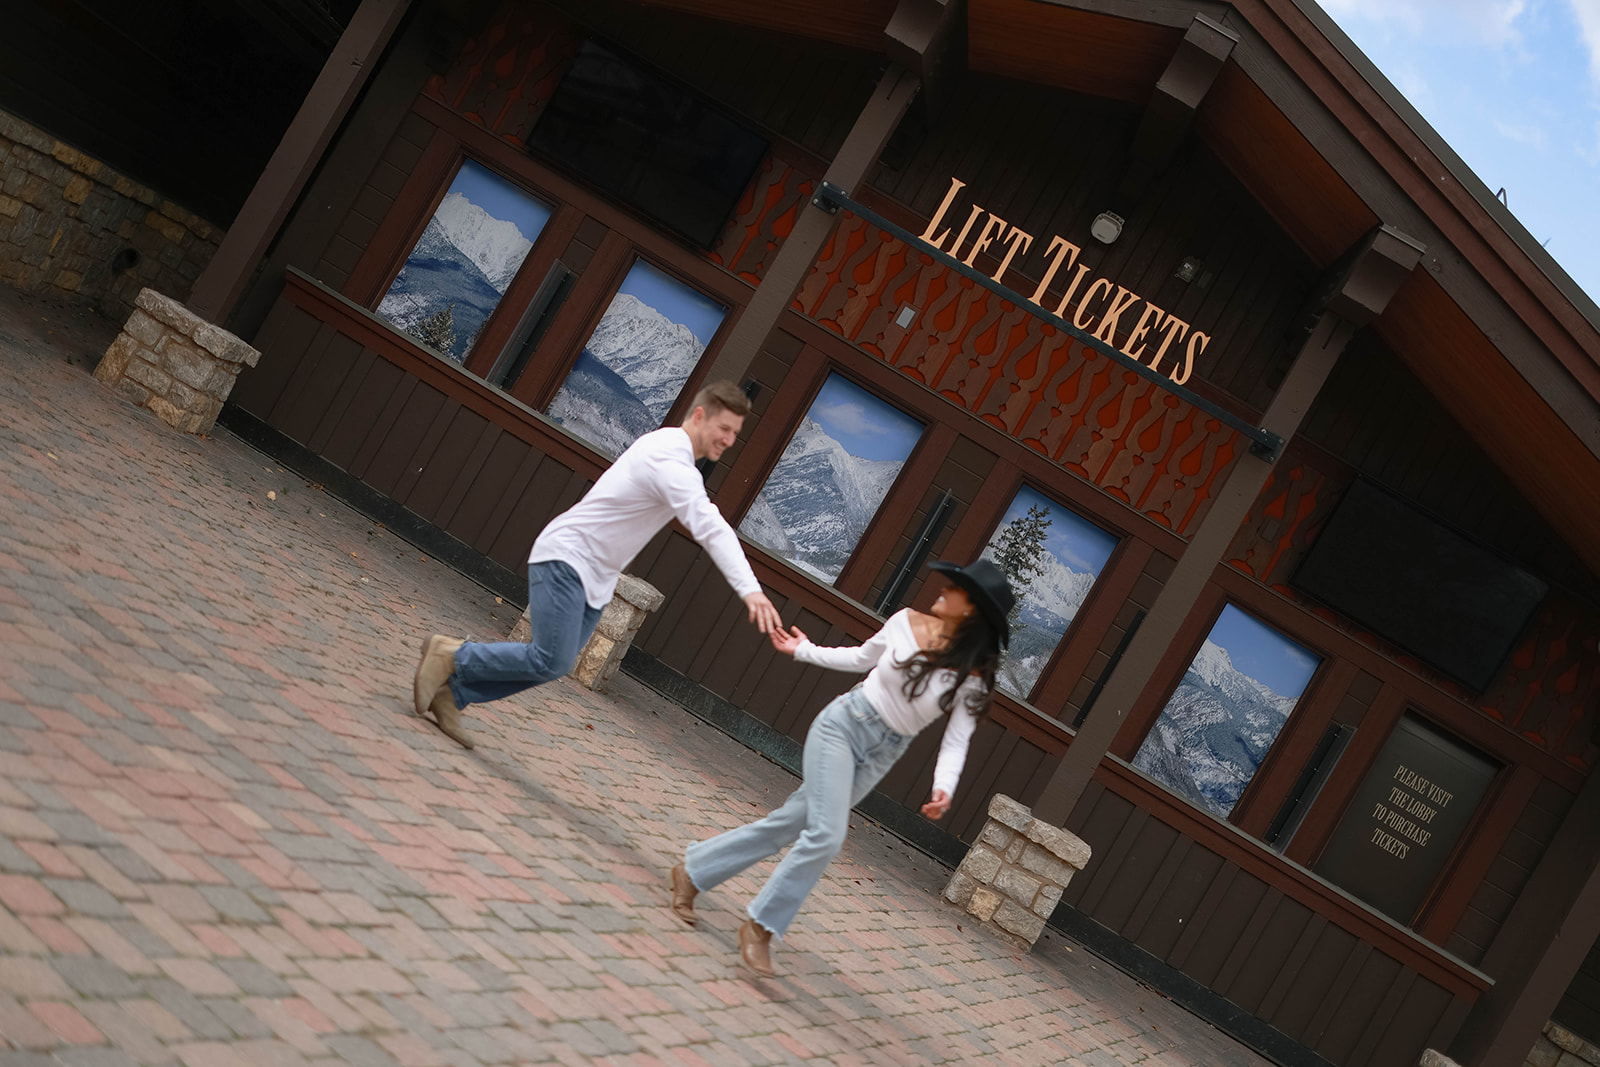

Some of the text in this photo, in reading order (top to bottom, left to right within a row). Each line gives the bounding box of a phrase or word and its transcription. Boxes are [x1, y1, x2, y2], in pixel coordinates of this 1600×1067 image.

[918, 177, 1211, 386] LIFT TICKETS
[1388, 786, 1438, 824] THE LOBBY
[1393, 765, 1453, 808] PLEASE VISIT
[1371, 827, 1410, 860] TICKETS
[1372, 802, 1432, 847] TO PURCHASE
